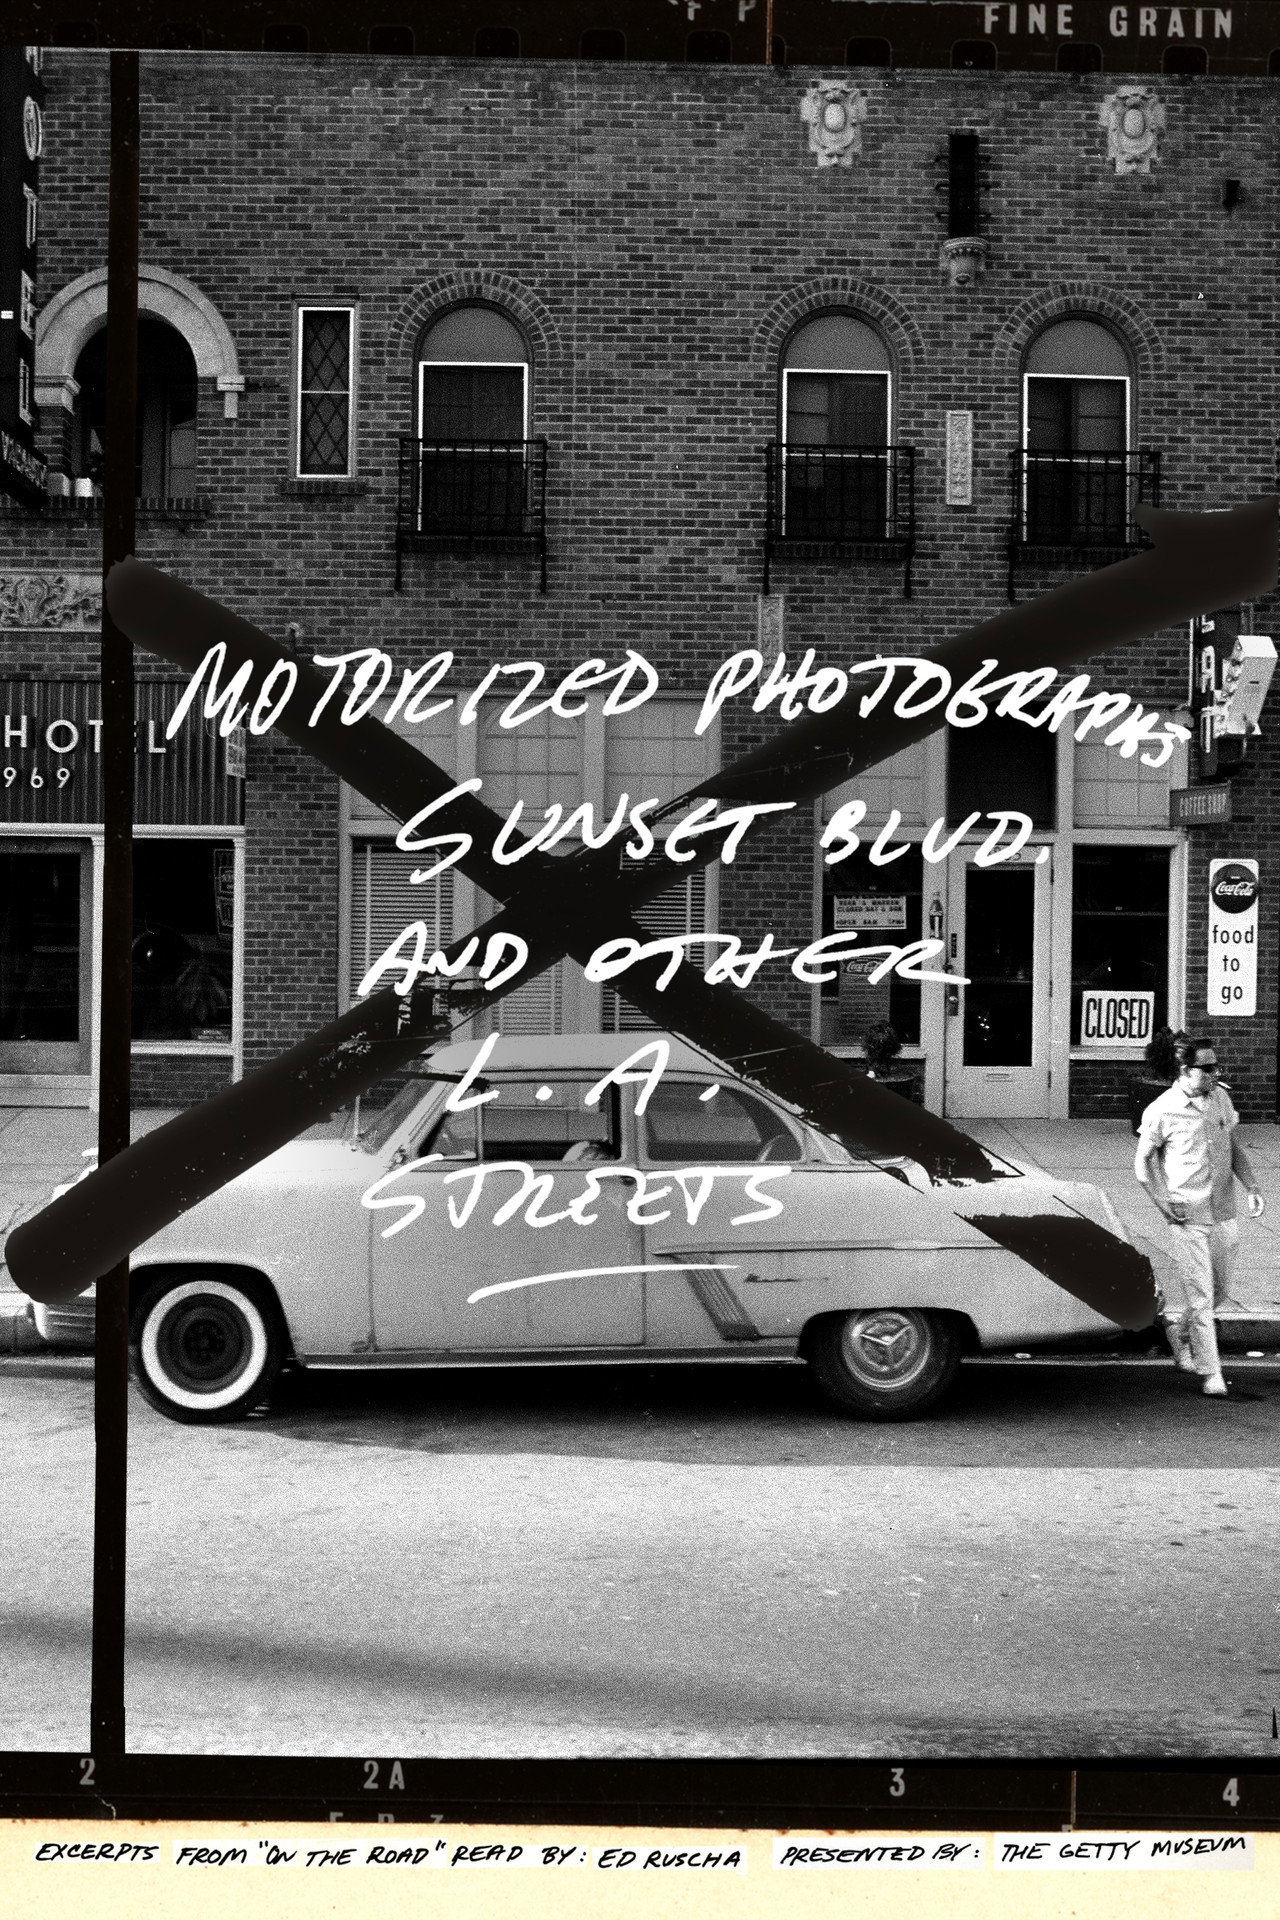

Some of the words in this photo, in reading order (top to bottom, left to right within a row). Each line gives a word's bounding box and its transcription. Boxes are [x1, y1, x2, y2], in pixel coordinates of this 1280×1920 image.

[984, 3, 1073, 35] FINE
[1109, 6, 1232, 38] GRAIN
[4, 714, 166, 754] HOTL
[3, 766, 71, 789] 969
[1179, 795, 1206, 818] COFFEE
[1207, 793, 1227, 815] SHOP
[1212, 924, 1255, 945] food
[1222, 955, 1240, 972] to
[1221, 985, 1243, 1005] go
[1084, 997, 1150, 1039] CLOSED
[79, 1758, 96, 1786] 2
[889, 1767, 906, 1798] 3
[1222, 1777, 1240, 1807] 4
